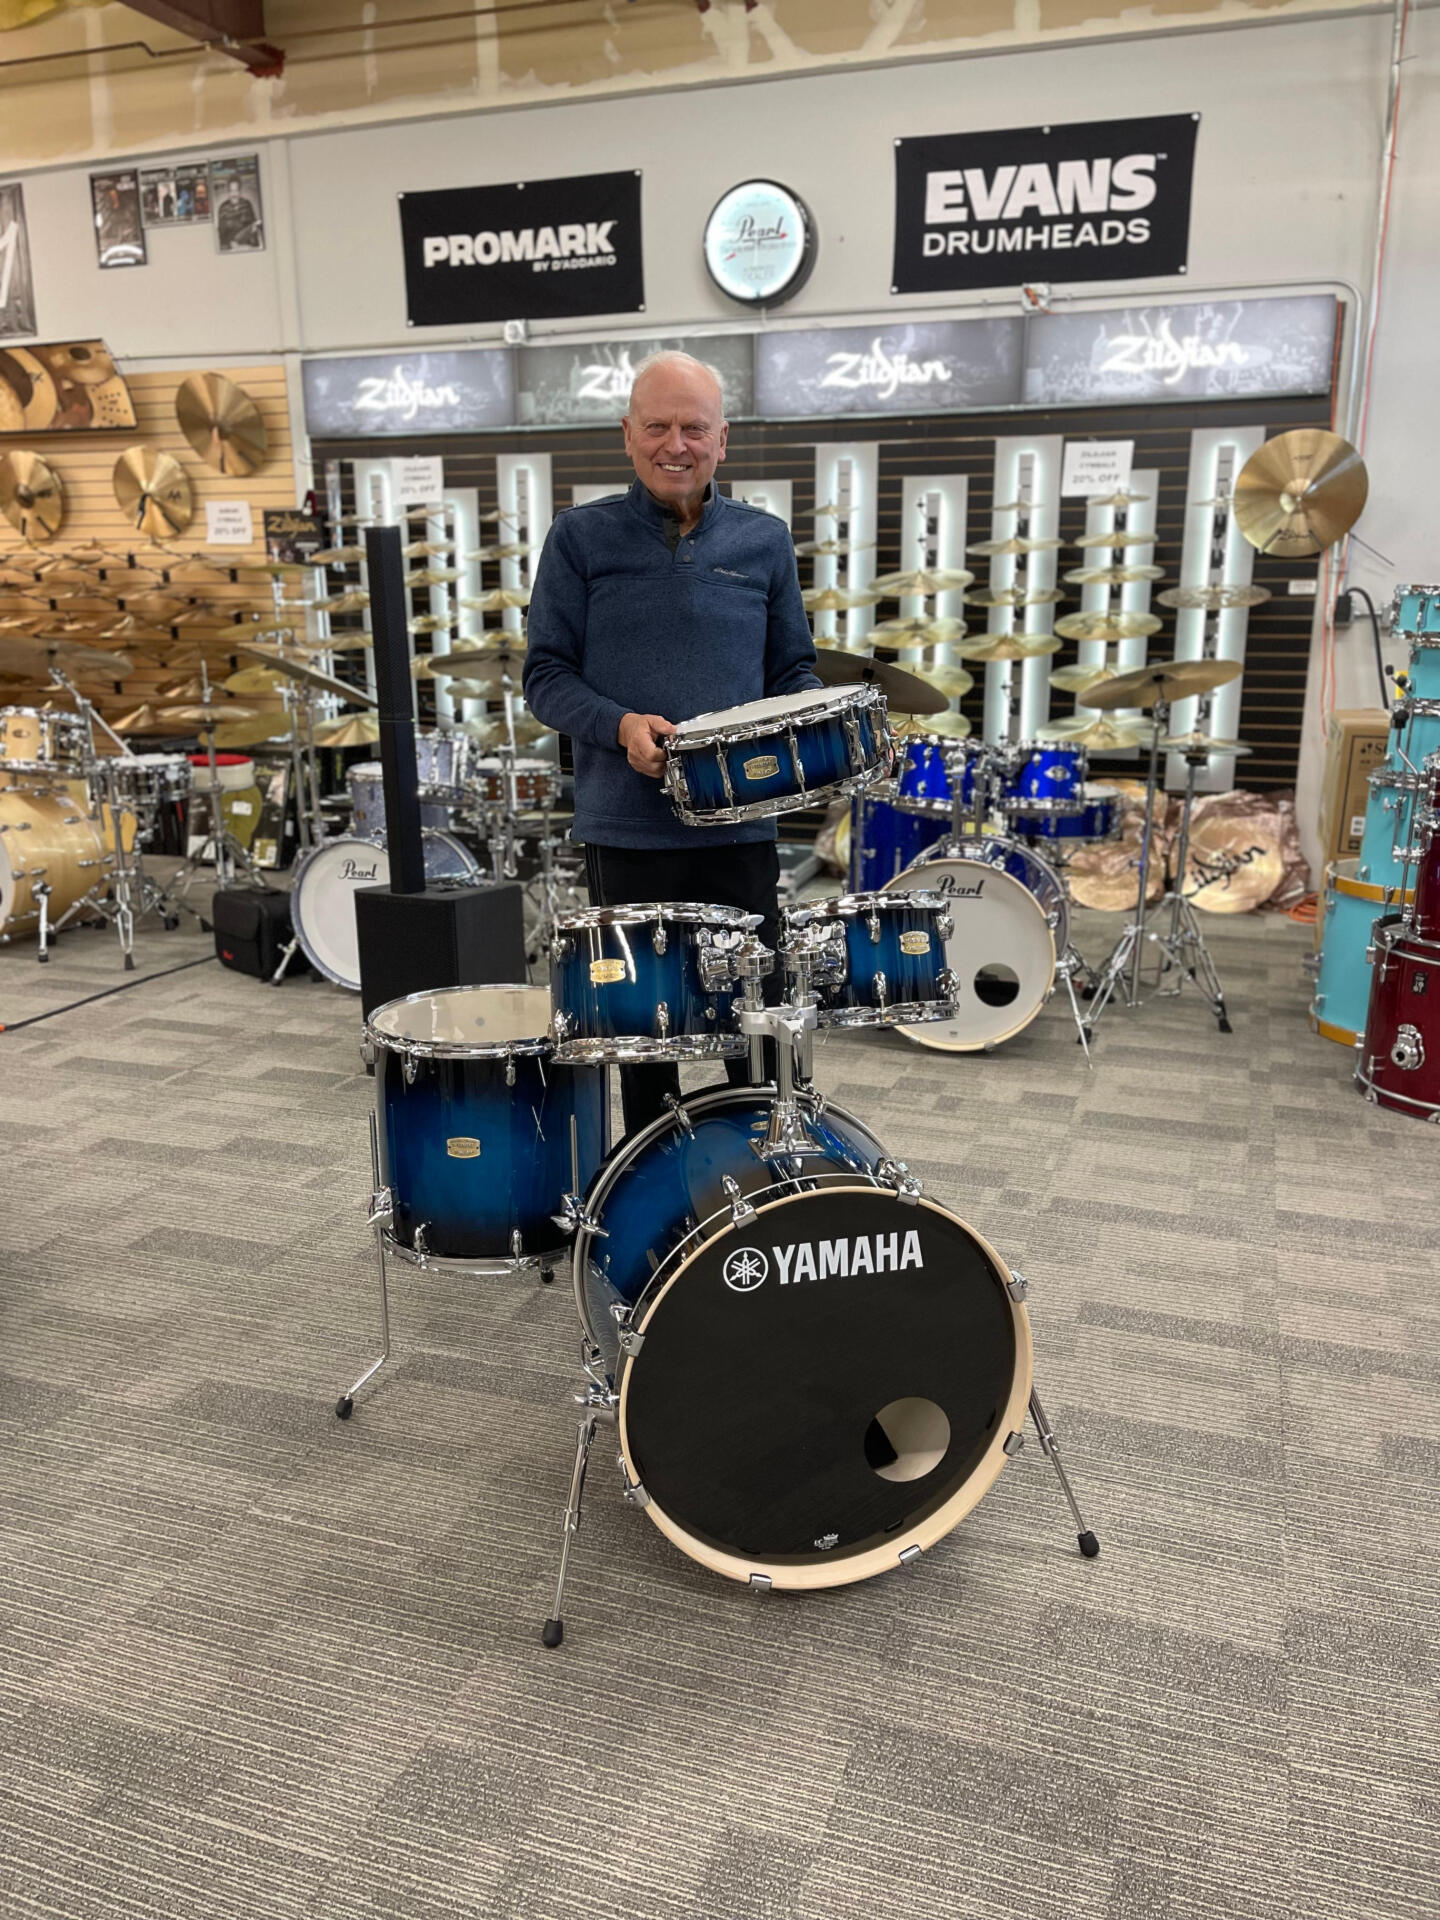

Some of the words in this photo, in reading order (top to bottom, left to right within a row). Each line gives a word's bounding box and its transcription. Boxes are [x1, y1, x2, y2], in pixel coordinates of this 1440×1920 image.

[924, 153, 1158, 225] EVANS
[423, 220, 616, 268] PROMARK
[730, 215, 784, 243] Pearl
[922, 217, 1151, 257] DRUMHEADS
[532, 261, 549, 272] BY
[551, 254, 617, 271] D'ADDARIO
[820, 337, 951, 399] Zildjian
[1101, 318, 1249, 385] Zildjian
[352, 363, 460, 421] Zildjian
[337, 859, 378, 881] Pearl
[936, 873, 985, 899] Pearl
[772, 1229, 924, 1284] YAMAHA
